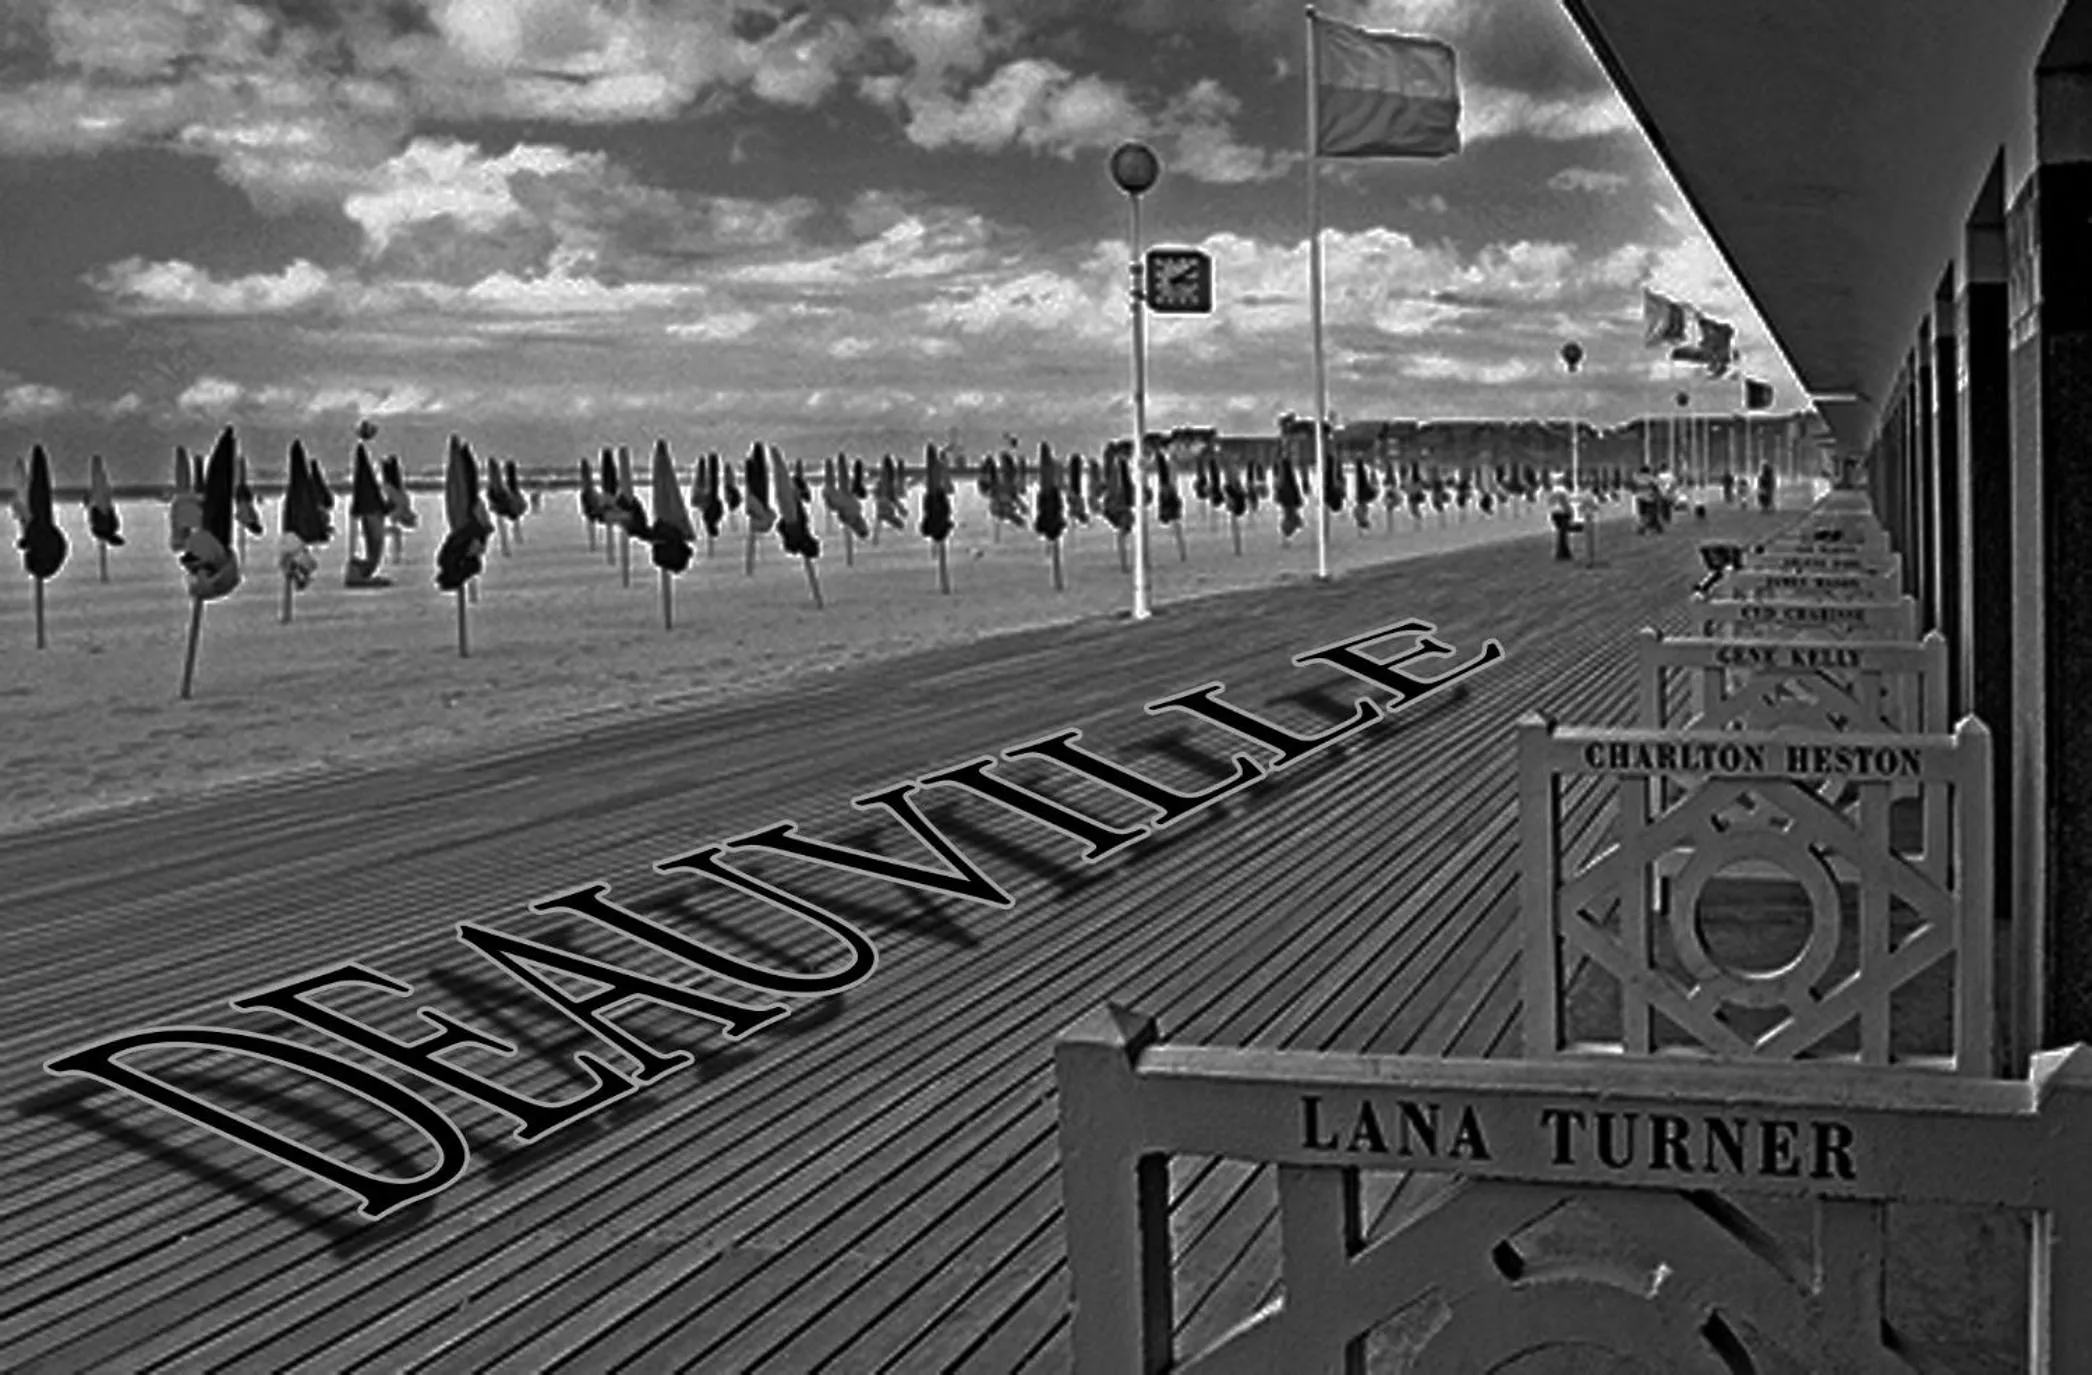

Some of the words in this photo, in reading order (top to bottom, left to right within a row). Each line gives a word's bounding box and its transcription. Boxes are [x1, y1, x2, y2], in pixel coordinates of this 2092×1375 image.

[1791, 648, 1860, 668] KELLY
[1584, 741, 1764, 772] CHARLTON
[1785, 745, 1923, 776] HESTON
[1300, 1096, 1490, 1161] LANA
[1540, 1108, 1857, 1180] TURNER
